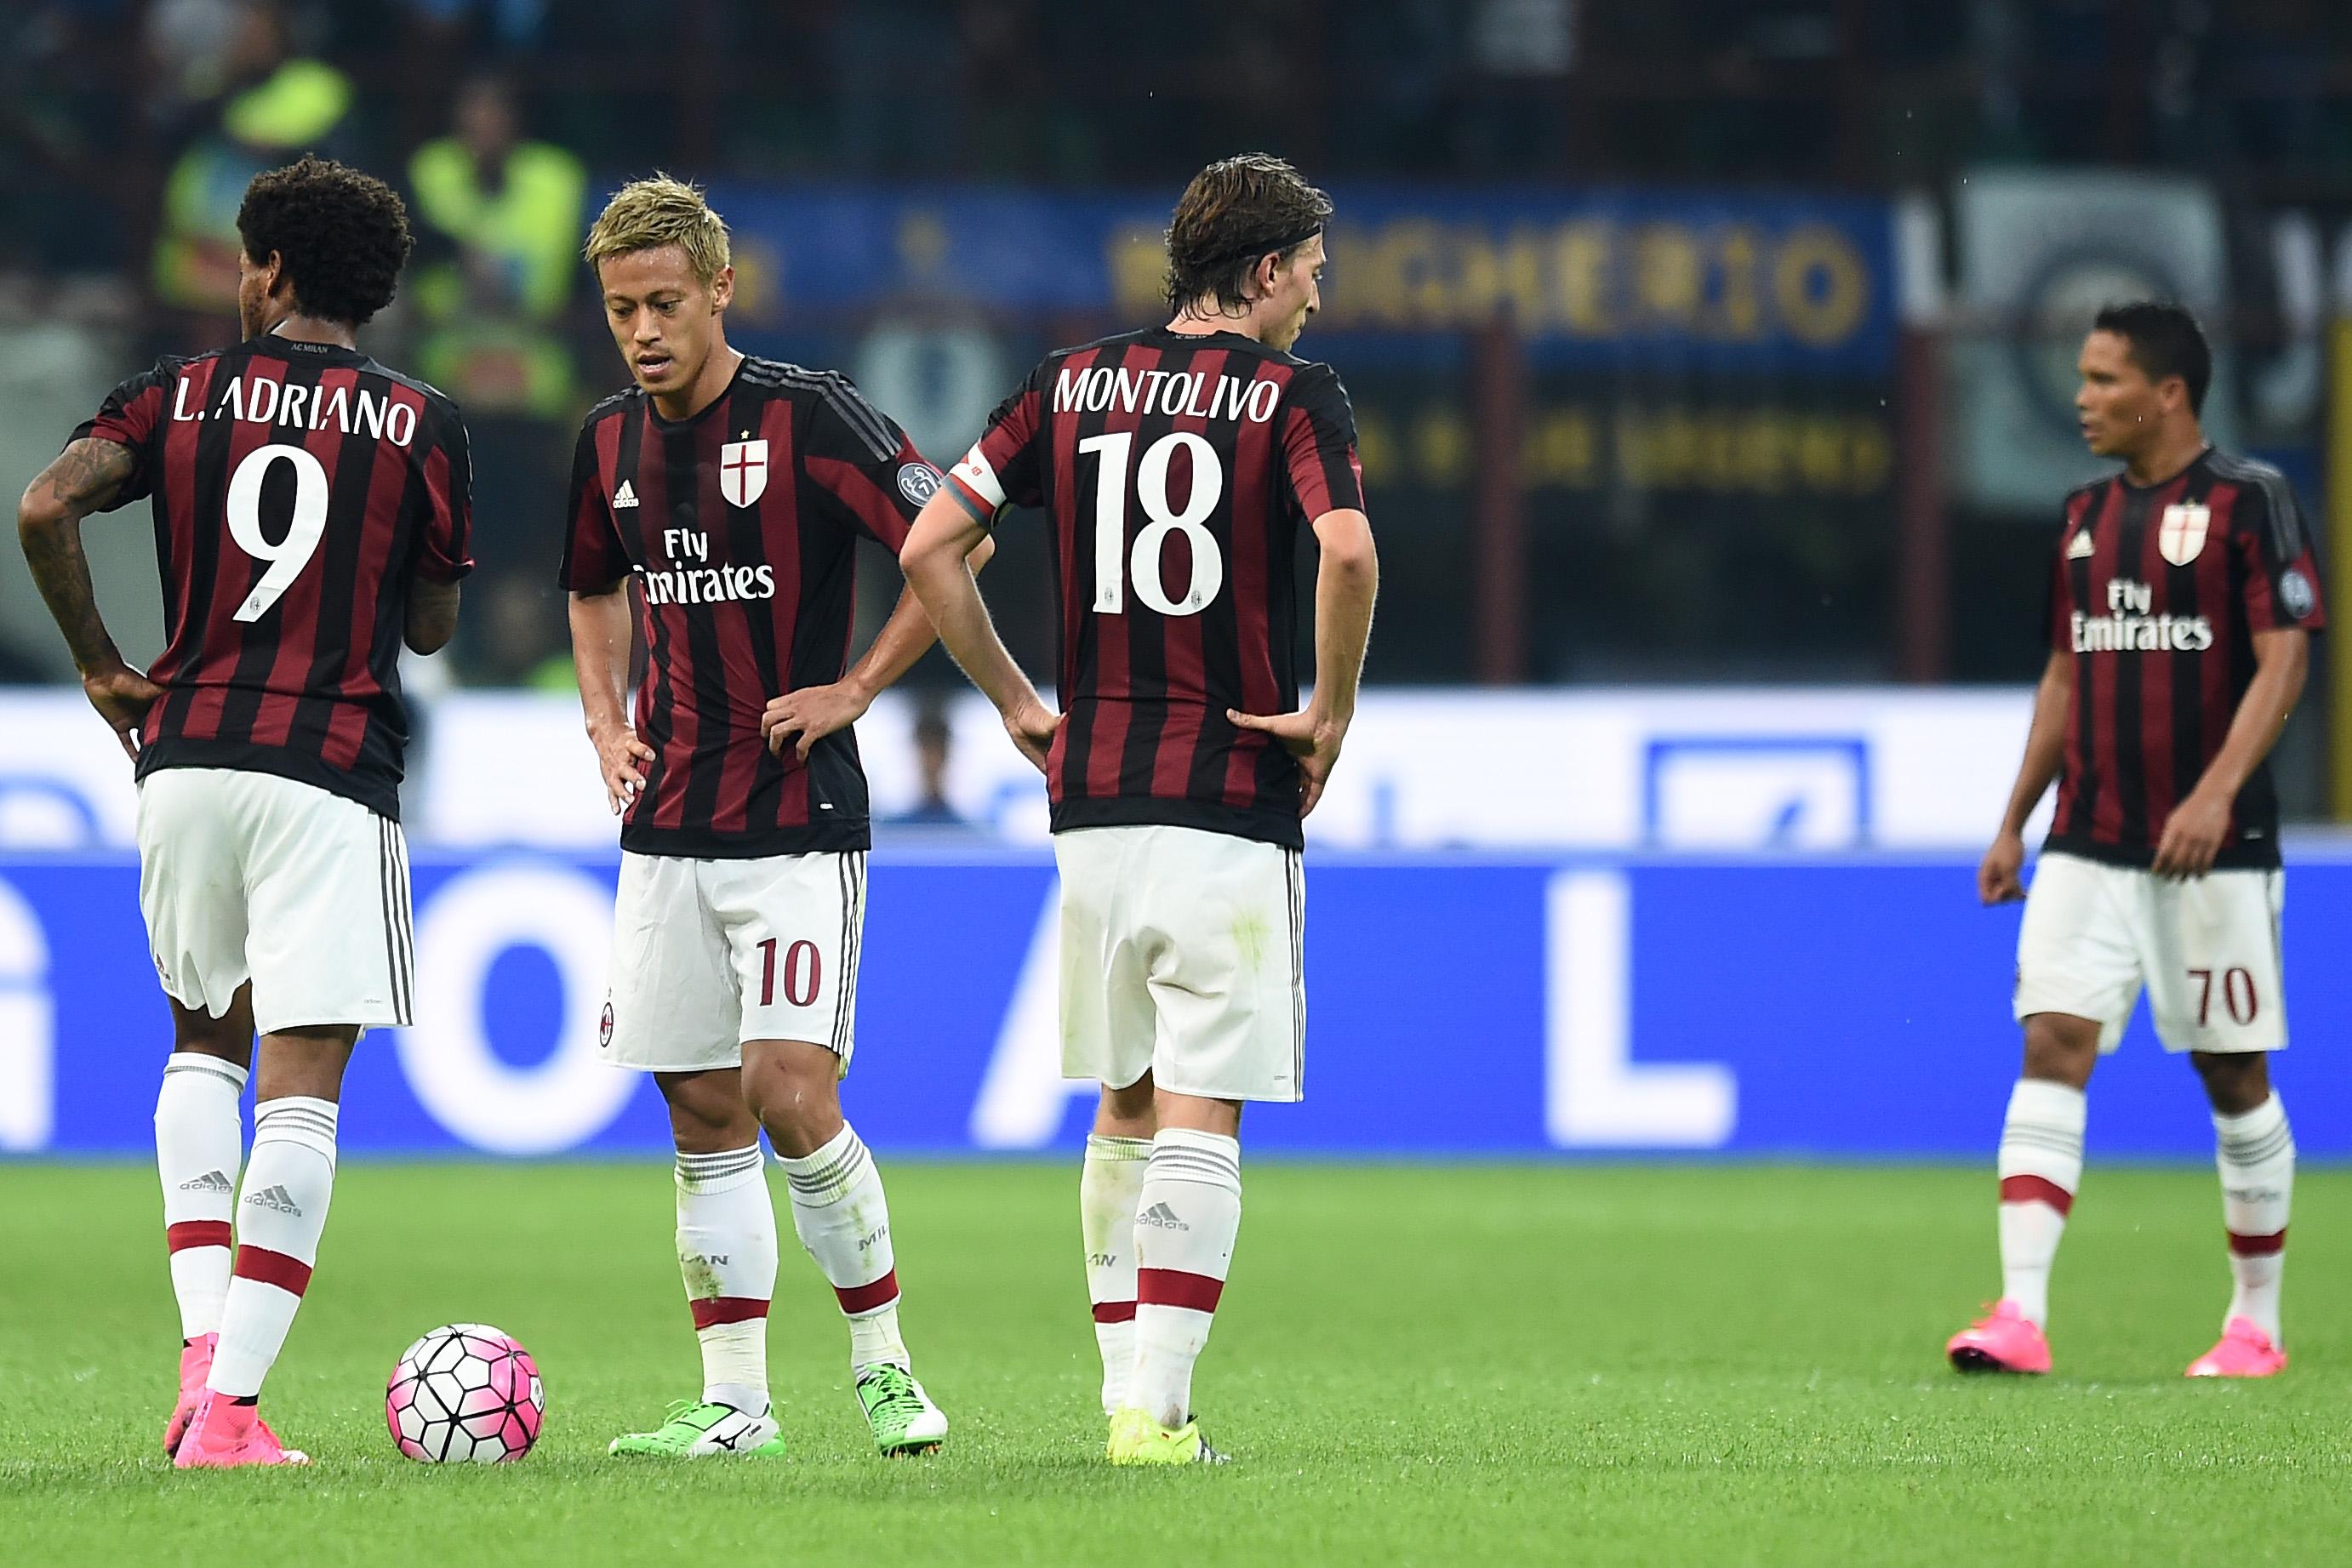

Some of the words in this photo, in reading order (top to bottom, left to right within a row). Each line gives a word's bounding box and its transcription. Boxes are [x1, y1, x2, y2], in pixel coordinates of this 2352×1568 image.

[173, 376, 206, 422] L.
[213, 375, 417, 448] ADRIANO
[1052, 367, 1280, 424] MONTOLIVO
[226, 443, 329, 624] 9
[663, 527, 708, 562] Fly
[1077, 430, 1224, 617] 18
[2106, 578, 2153, 615] Fly
[2069, 609, 2215, 653] Emirates
[756, 937, 822, 1007] 10
[2186, 967, 2258, 1028] 70
[243, 1195, 302, 1217] adidas
